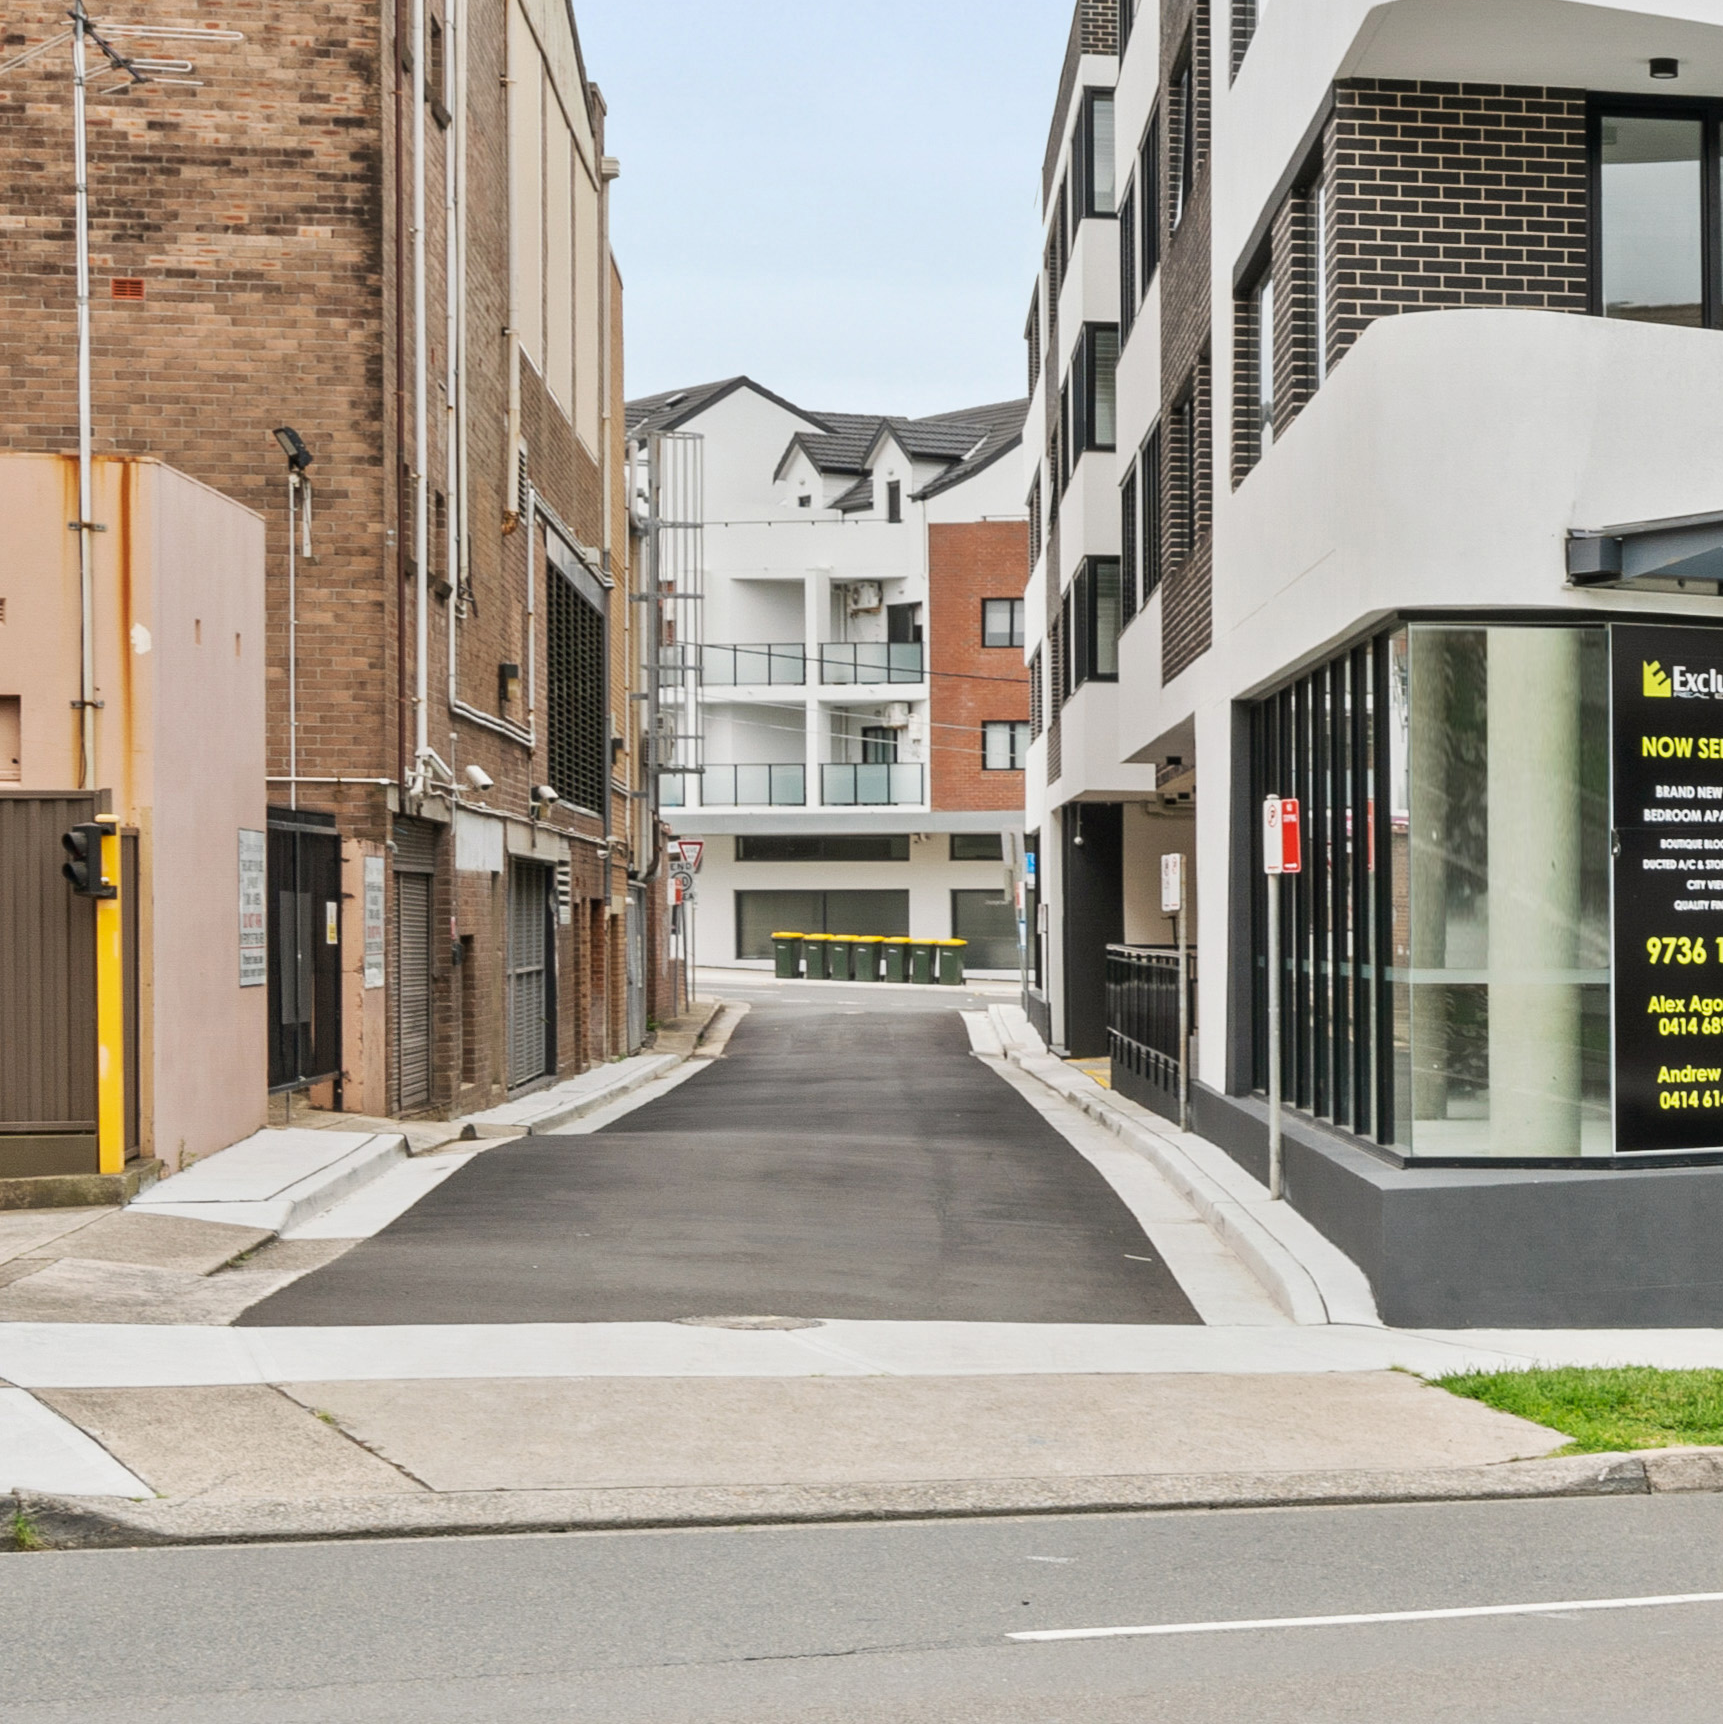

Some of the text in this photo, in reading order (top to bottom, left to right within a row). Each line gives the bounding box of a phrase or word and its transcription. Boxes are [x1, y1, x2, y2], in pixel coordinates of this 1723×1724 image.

[1641, 736, 1693, 758] NOW
[1655, 786, 1695, 799] BRAND
[1697, 786, 1722, 799] NEW
[1643, 809, 1702, 822] BEDROOM
[1660, 839, 1702, 850] BOUTIQUE
[670, 863, 691, 871] END
[1643, 859, 1677, 870] DUCTED
[1678, 859, 1696, 871] A/C
[1697, 859, 1704, 870] &
[1687, 880, 1706, 890] CITY
[1674, 900, 1710, 911] QUALITY
[1646, 936, 1707, 964] 9736
[1647, 995, 1685, 1013] Alex
[1658, 1017, 1698, 1036] 0414
[1657, 1065, 1721, 1083] Andrew
[1659, 1091, 1699, 1109] 0414
